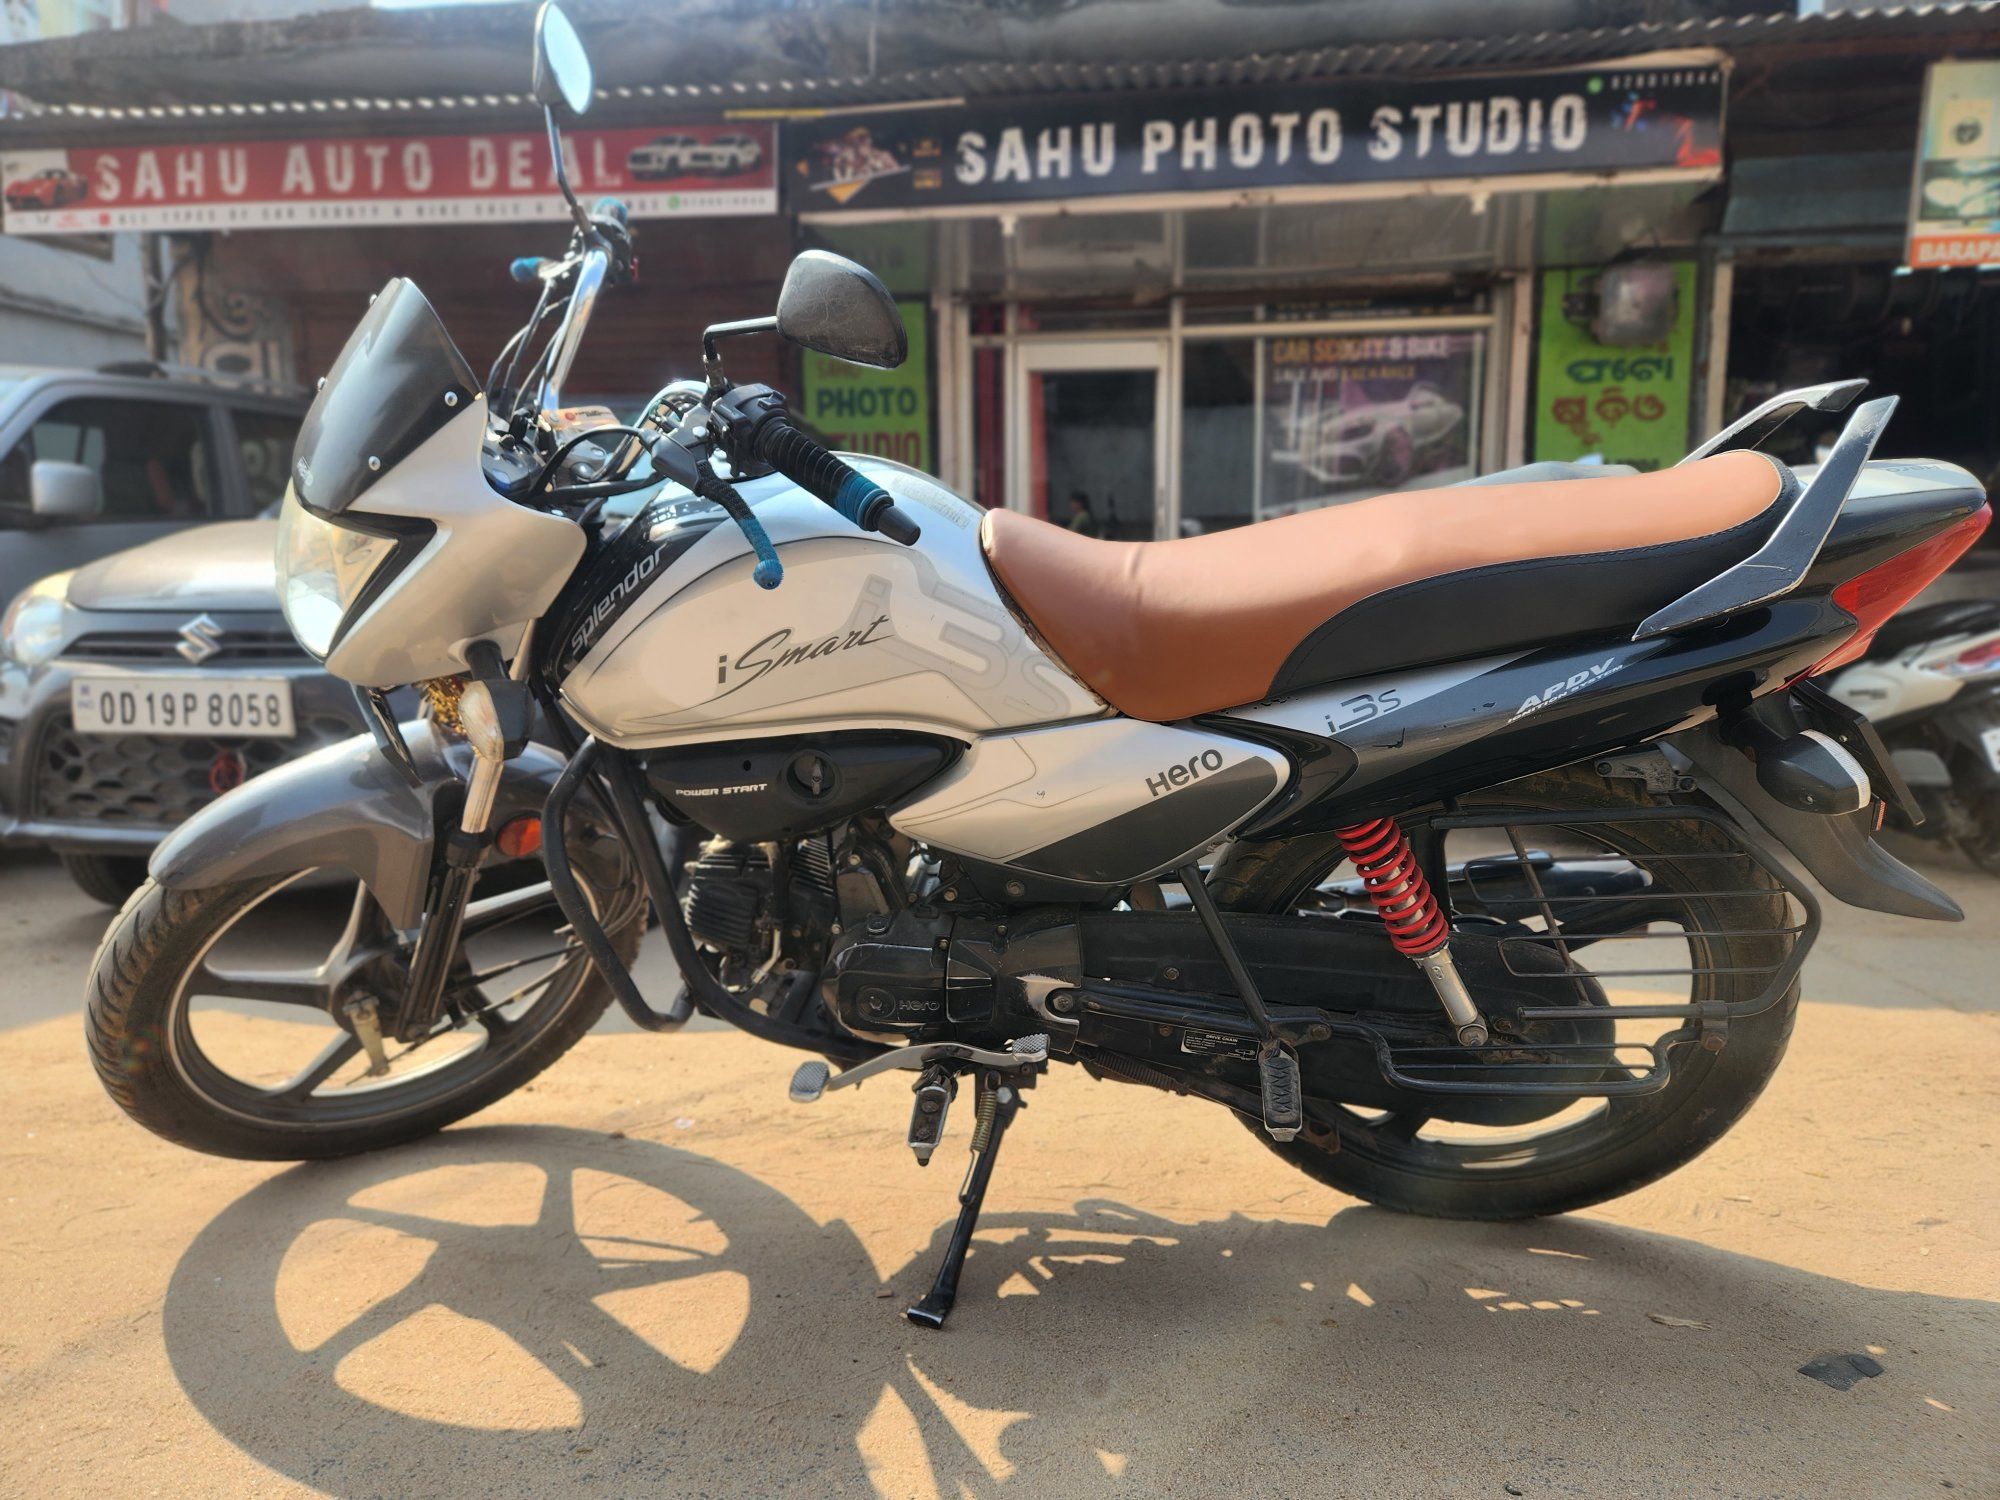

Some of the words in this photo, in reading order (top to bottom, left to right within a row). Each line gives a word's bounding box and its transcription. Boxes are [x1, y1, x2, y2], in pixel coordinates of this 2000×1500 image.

[955, 123, 1115, 184] SAHU
[1141, 108, 1342, 173] PHOTO
[1367, 94, 1588, 161] STUDIO
[94, 149, 248, 201] SAHU
[281, 142, 433, 195] AUTO
[469, 136, 622, 190] DEAL
[816, 386, 918, 418] PHOTO
[1516, 656, 1616, 715] APDV
[675, 788, 720, 797] POWER
[722, 783, 768, 795] START
[1145, 749, 1223, 797] Hero
